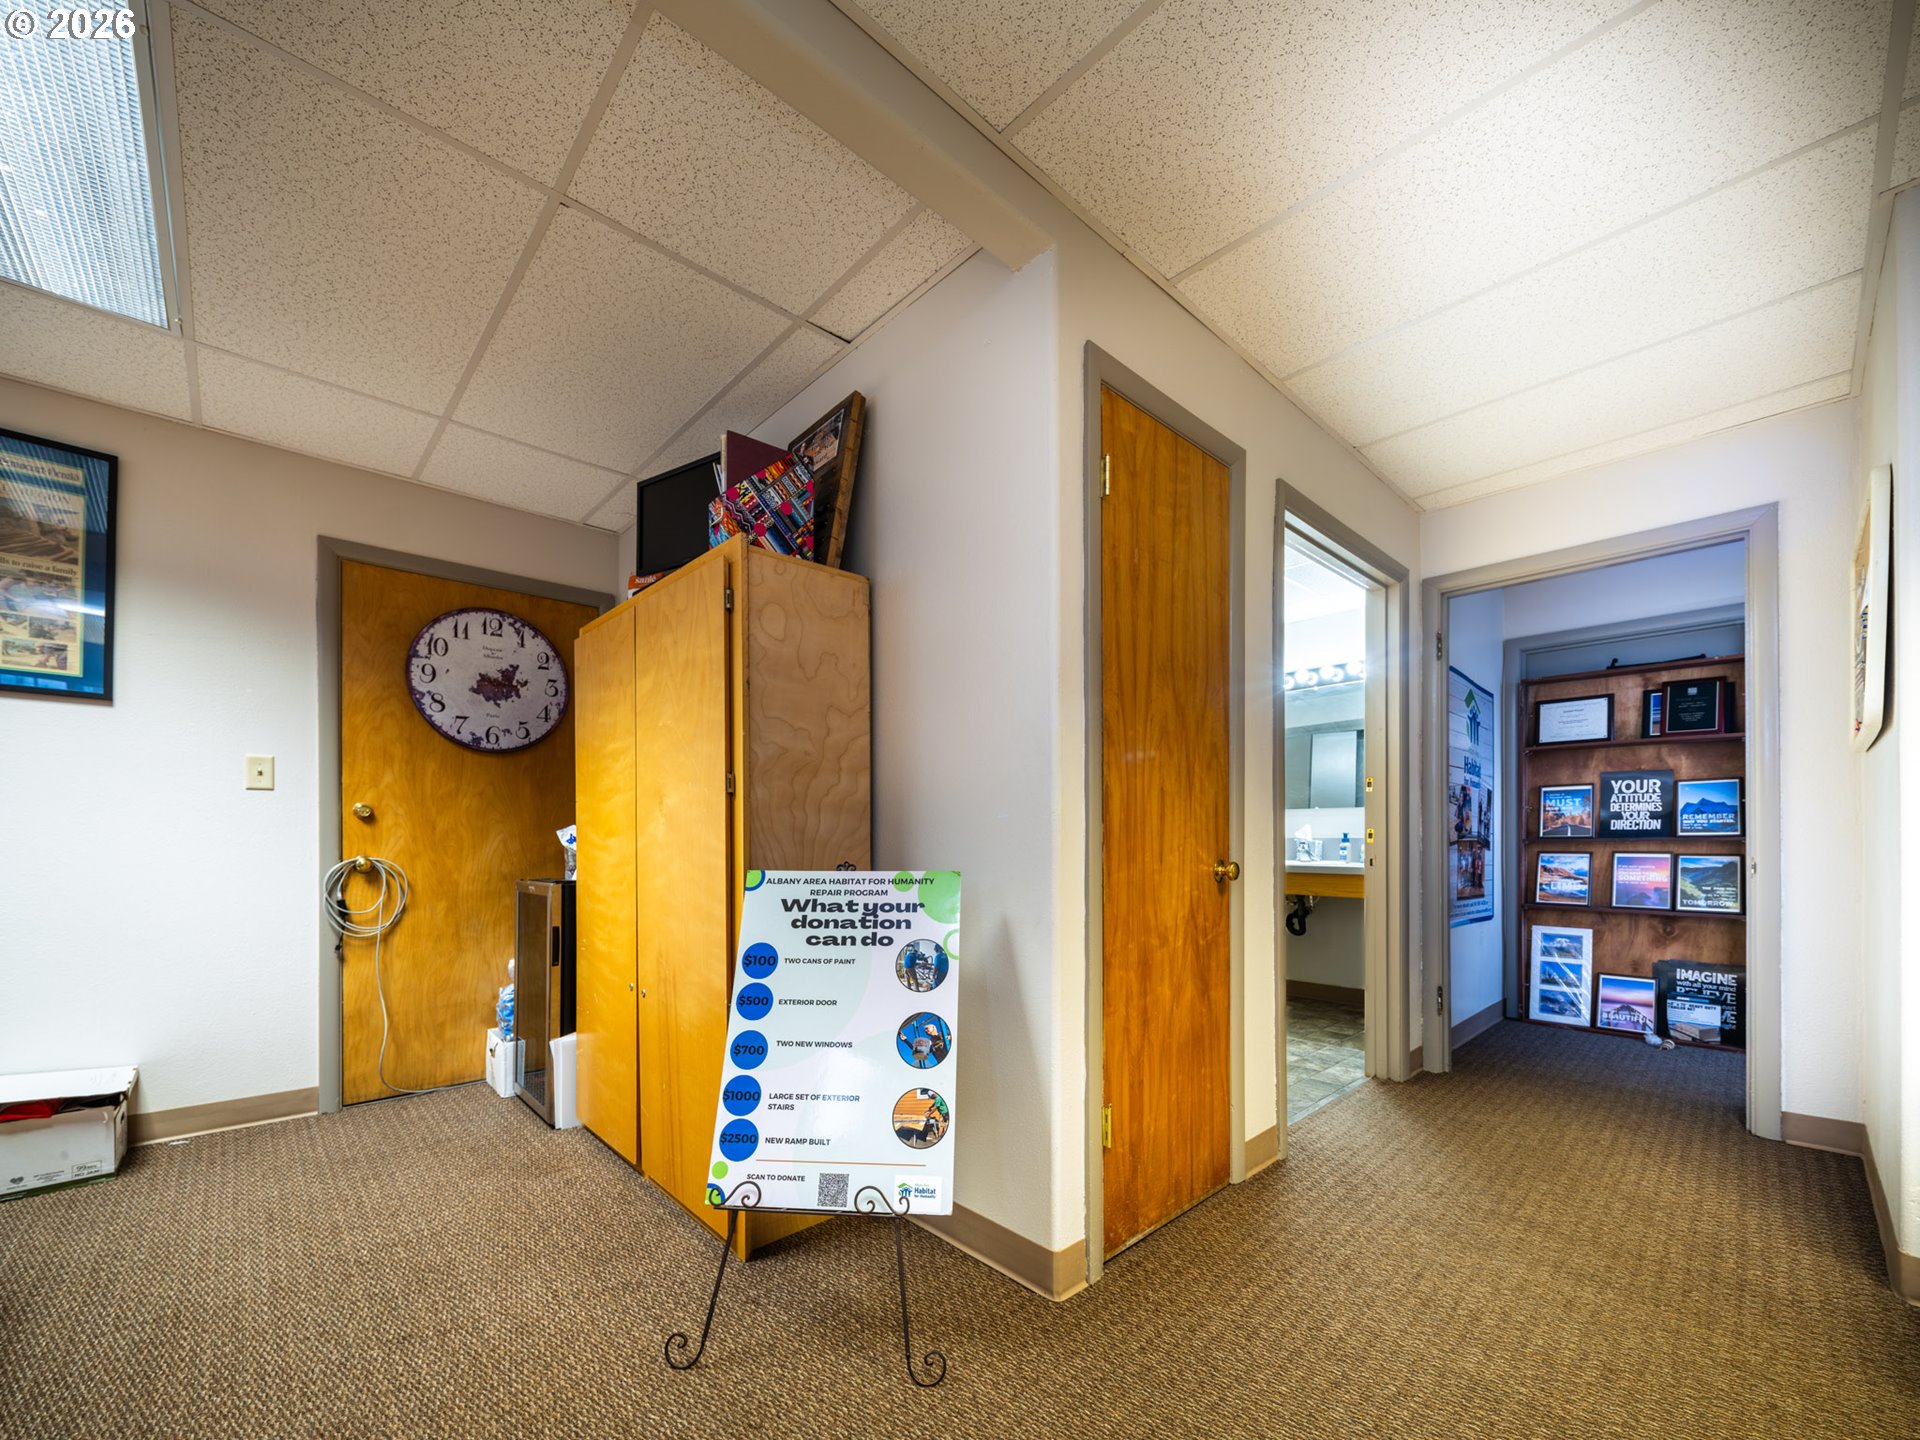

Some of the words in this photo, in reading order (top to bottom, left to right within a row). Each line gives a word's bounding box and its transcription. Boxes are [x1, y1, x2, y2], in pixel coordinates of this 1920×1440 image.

[52, 566, 77, 576] family
[452, 618, 470, 640] 11
[482, 617, 503, 638] 12
[426, 634, 448, 656] 10
[517, 630, 526, 648] 1
[538, 652, 550, 670] 2
[420, 664, 436, 684] 9
[545, 679, 558, 698] 3
[429, 693, 446, 712] 8
[536, 705, 550, 722] 4
[454, 716, 470, 734] 7
[516, 722, 530, 739] 5
[485, 726, 499, 744] 6
[1610, 779, 1661, 794] YOUR
[1546, 798, 1582, 806] MUST
[1610, 793, 1662, 803] ATTITUDE
[1610, 802, 1662, 812] DETERMINES
[1621, 812, 1650, 820] YOUR
[1610, 819, 1662, 830] DIRECTION
[781, 898, 860, 913] What
[863, 901, 925, 917] your
[791, 914, 912, 930] donation
[806, 934, 857, 946] can
[861, 932, 894, 946] do
[744, 955, 776, 967] $100
[1676, 968, 1737, 986] IMAGINE
[738, 996, 769, 1007] $500
[1603, 1012, 1652, 1024] BEAUTIFU
[733, 1045, 765, 1056] $700
[723, 1090, 760, 1101] $1000
[720, 1133, 758, 1144] $2500
